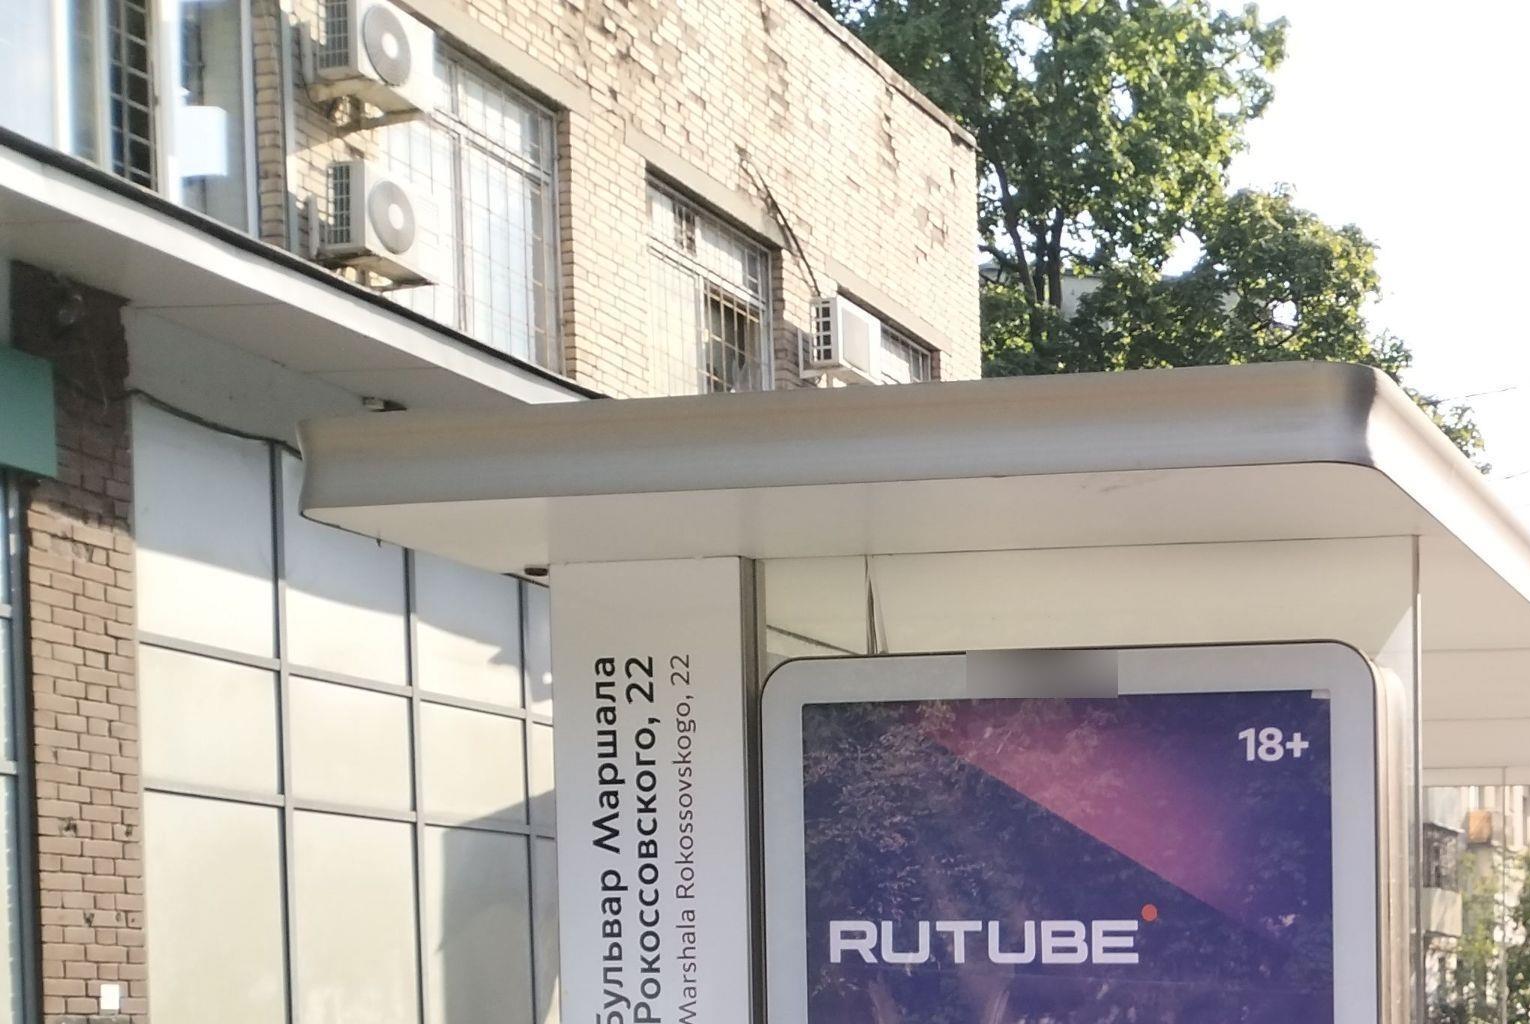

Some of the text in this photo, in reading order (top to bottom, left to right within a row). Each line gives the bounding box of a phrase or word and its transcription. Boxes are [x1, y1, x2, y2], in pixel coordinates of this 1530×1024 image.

[670, 654, 690, 685] 22
[591, 656, 625, 854] Маршала
[672, 694, 697, 899] Rokossovskogo,
[1238, 727, 1309, 762] 18+
[625, 655, 661, 1024] Рокоссовского, 22
[829, 919, 1139, 964] RUTUBE
